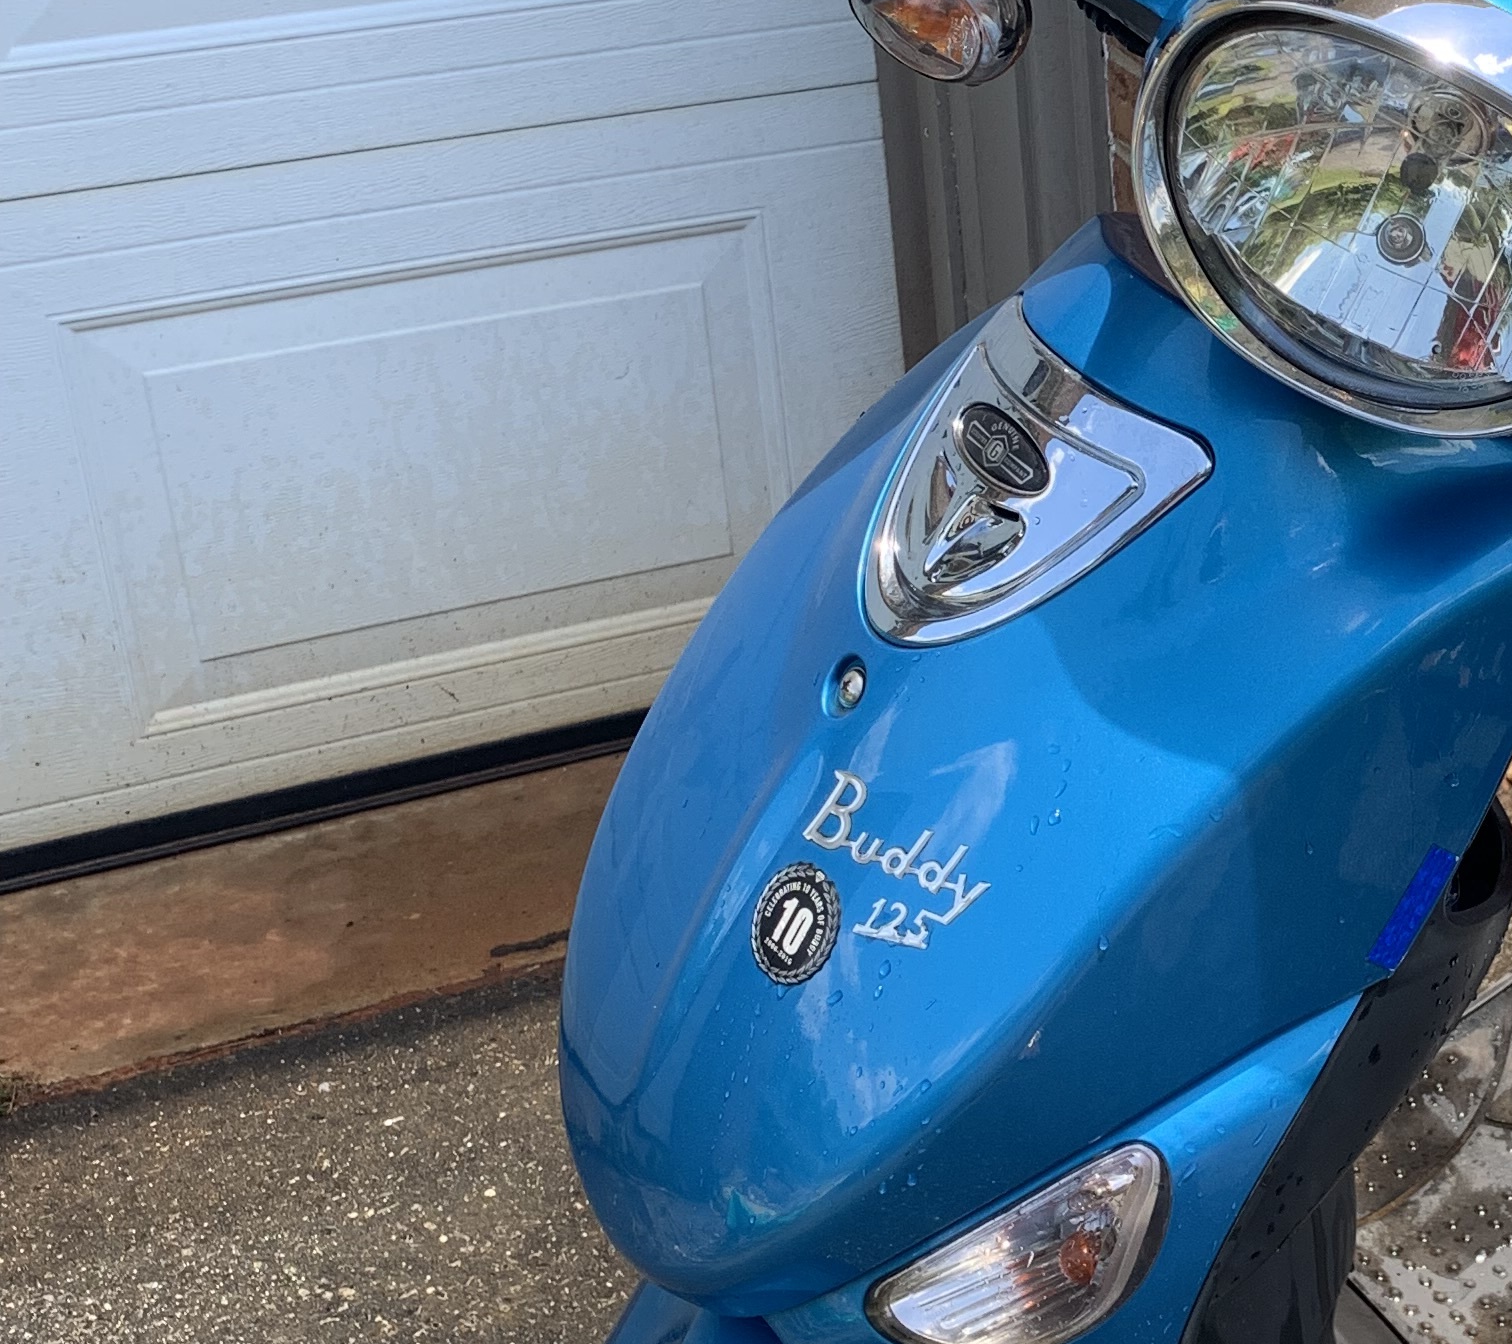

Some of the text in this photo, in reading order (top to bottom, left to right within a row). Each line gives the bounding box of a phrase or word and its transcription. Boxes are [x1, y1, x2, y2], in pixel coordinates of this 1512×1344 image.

[991, 422, 1020, 451] GENUINE
[802, 769, 992, 925] Buddy
[764, 881, 826, 957] CELEBRATING 10 YEARS OF BUDDY
[771, 897, 814, 956] 10
[852, 898, 929, 949] 125
